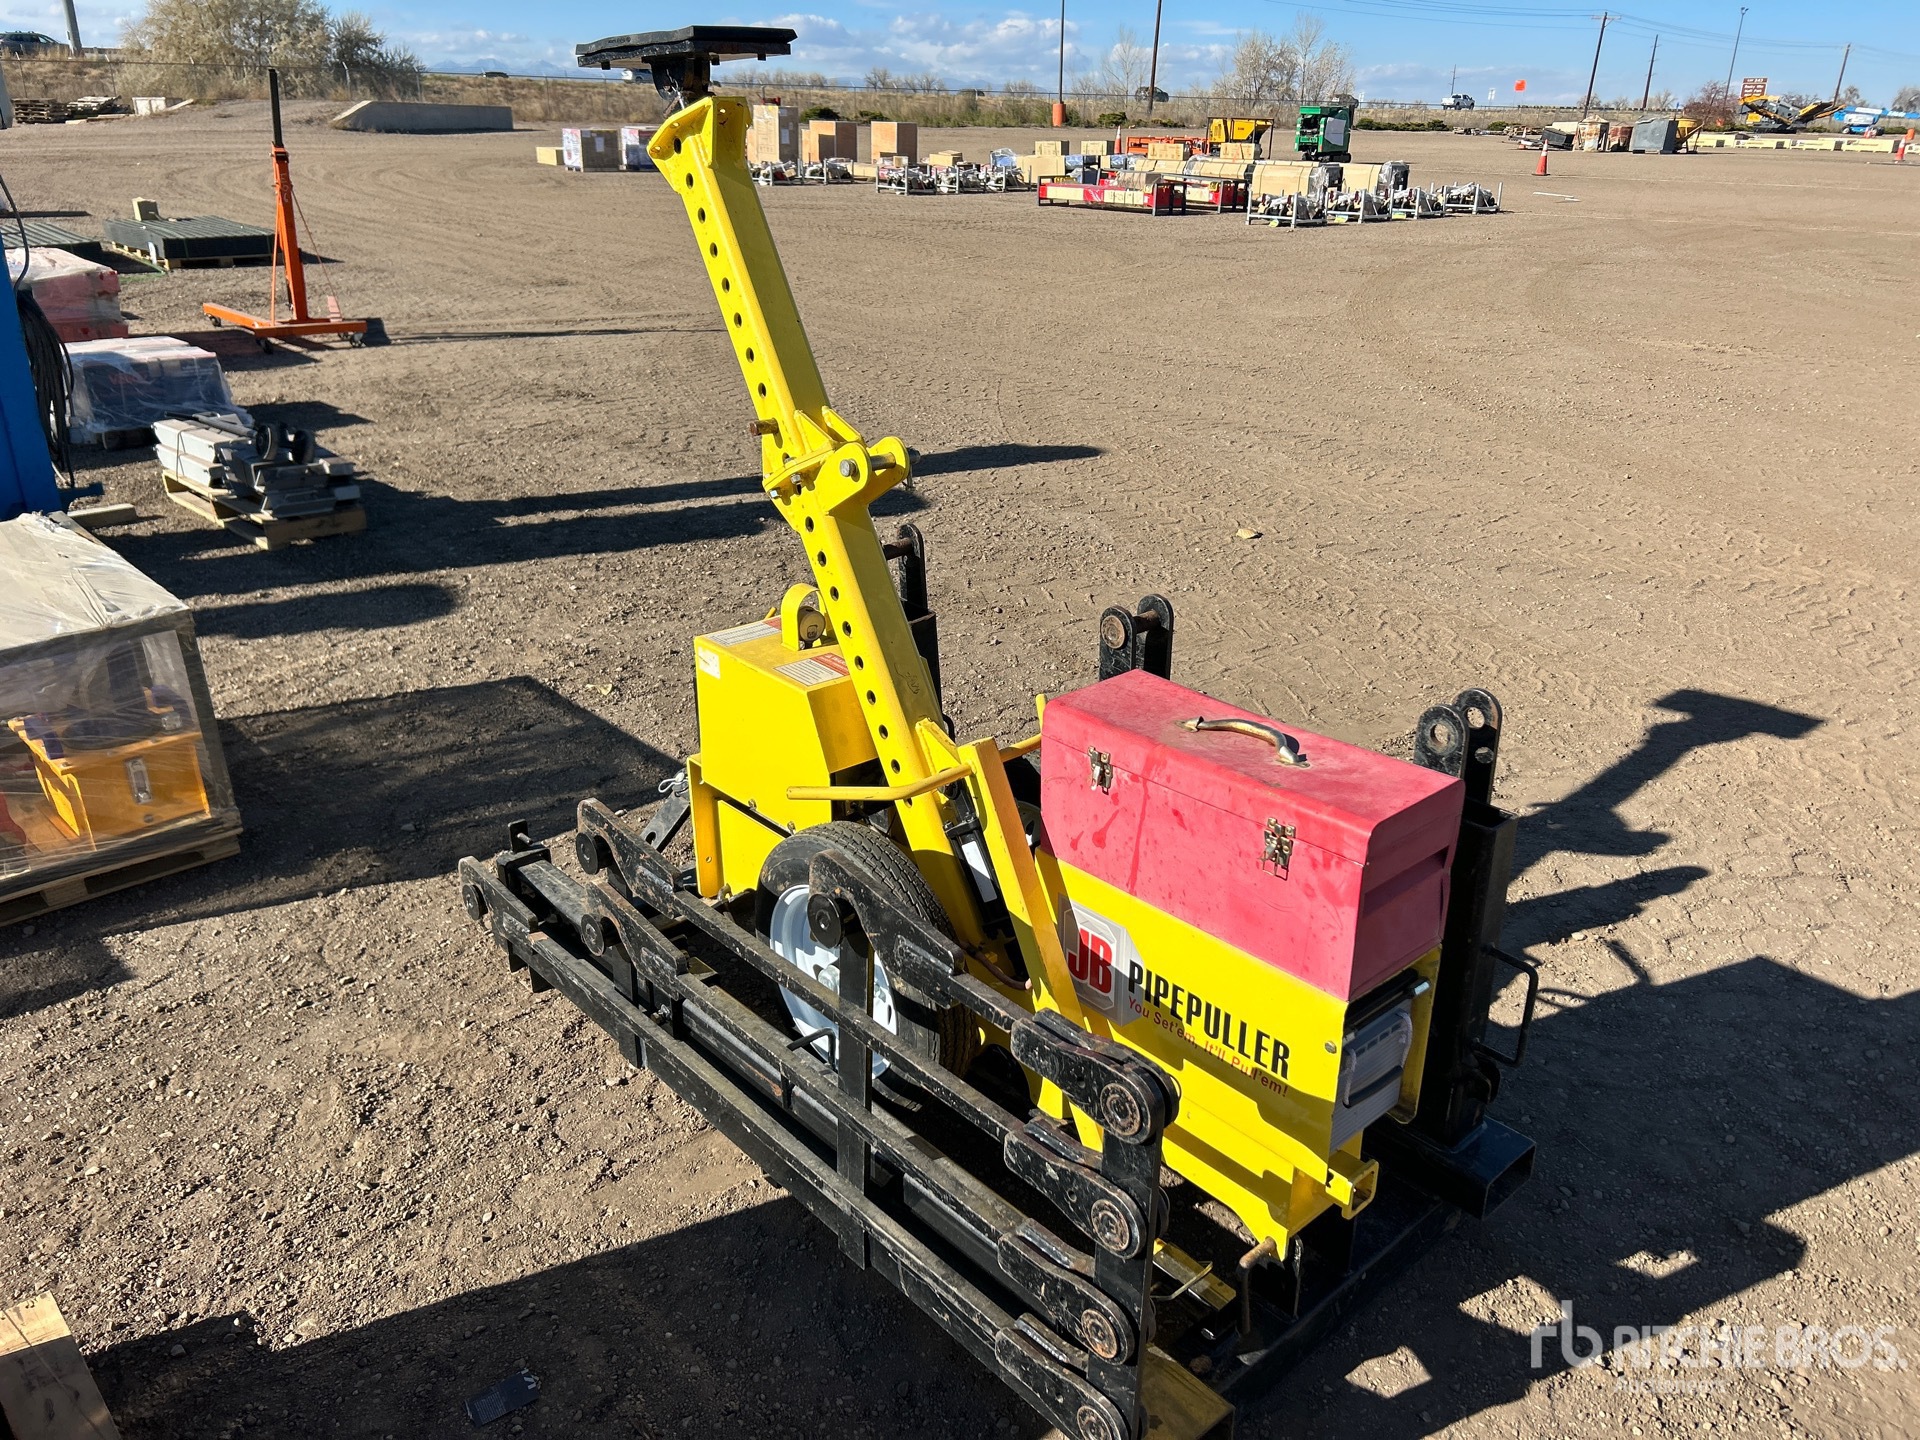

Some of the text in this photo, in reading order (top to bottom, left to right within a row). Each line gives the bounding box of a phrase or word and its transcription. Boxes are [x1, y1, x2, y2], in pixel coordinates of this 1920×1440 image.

[1067, 928, 1113, 994] JB
[1127, 958, 1291, 1080] PIPEPULLER
[1128, 995, 1150, 1019] You
[1231, 1054, 1289, 1098] Pull'em!
